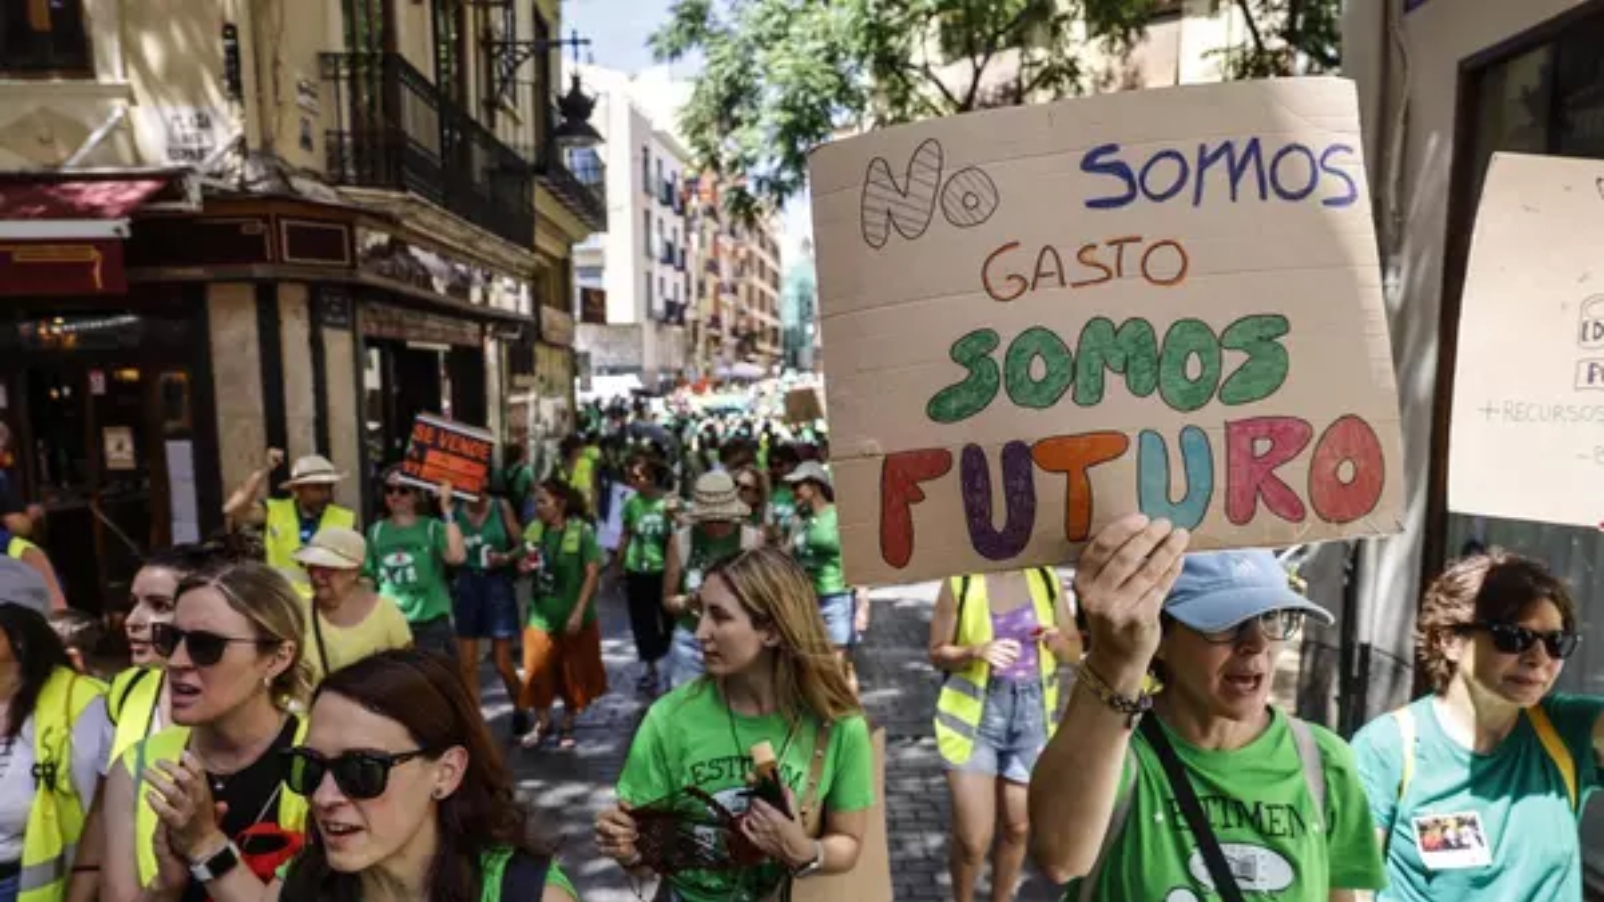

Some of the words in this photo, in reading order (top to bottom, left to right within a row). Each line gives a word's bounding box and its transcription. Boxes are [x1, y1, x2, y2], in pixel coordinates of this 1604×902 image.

[1080, 136, 1359, 209] SOMOS
[980, 236, 1190, 301] GASTO
[926, 314, 1291, 423] SOMOS
[879, 413, 1386, 570] FUTURO
